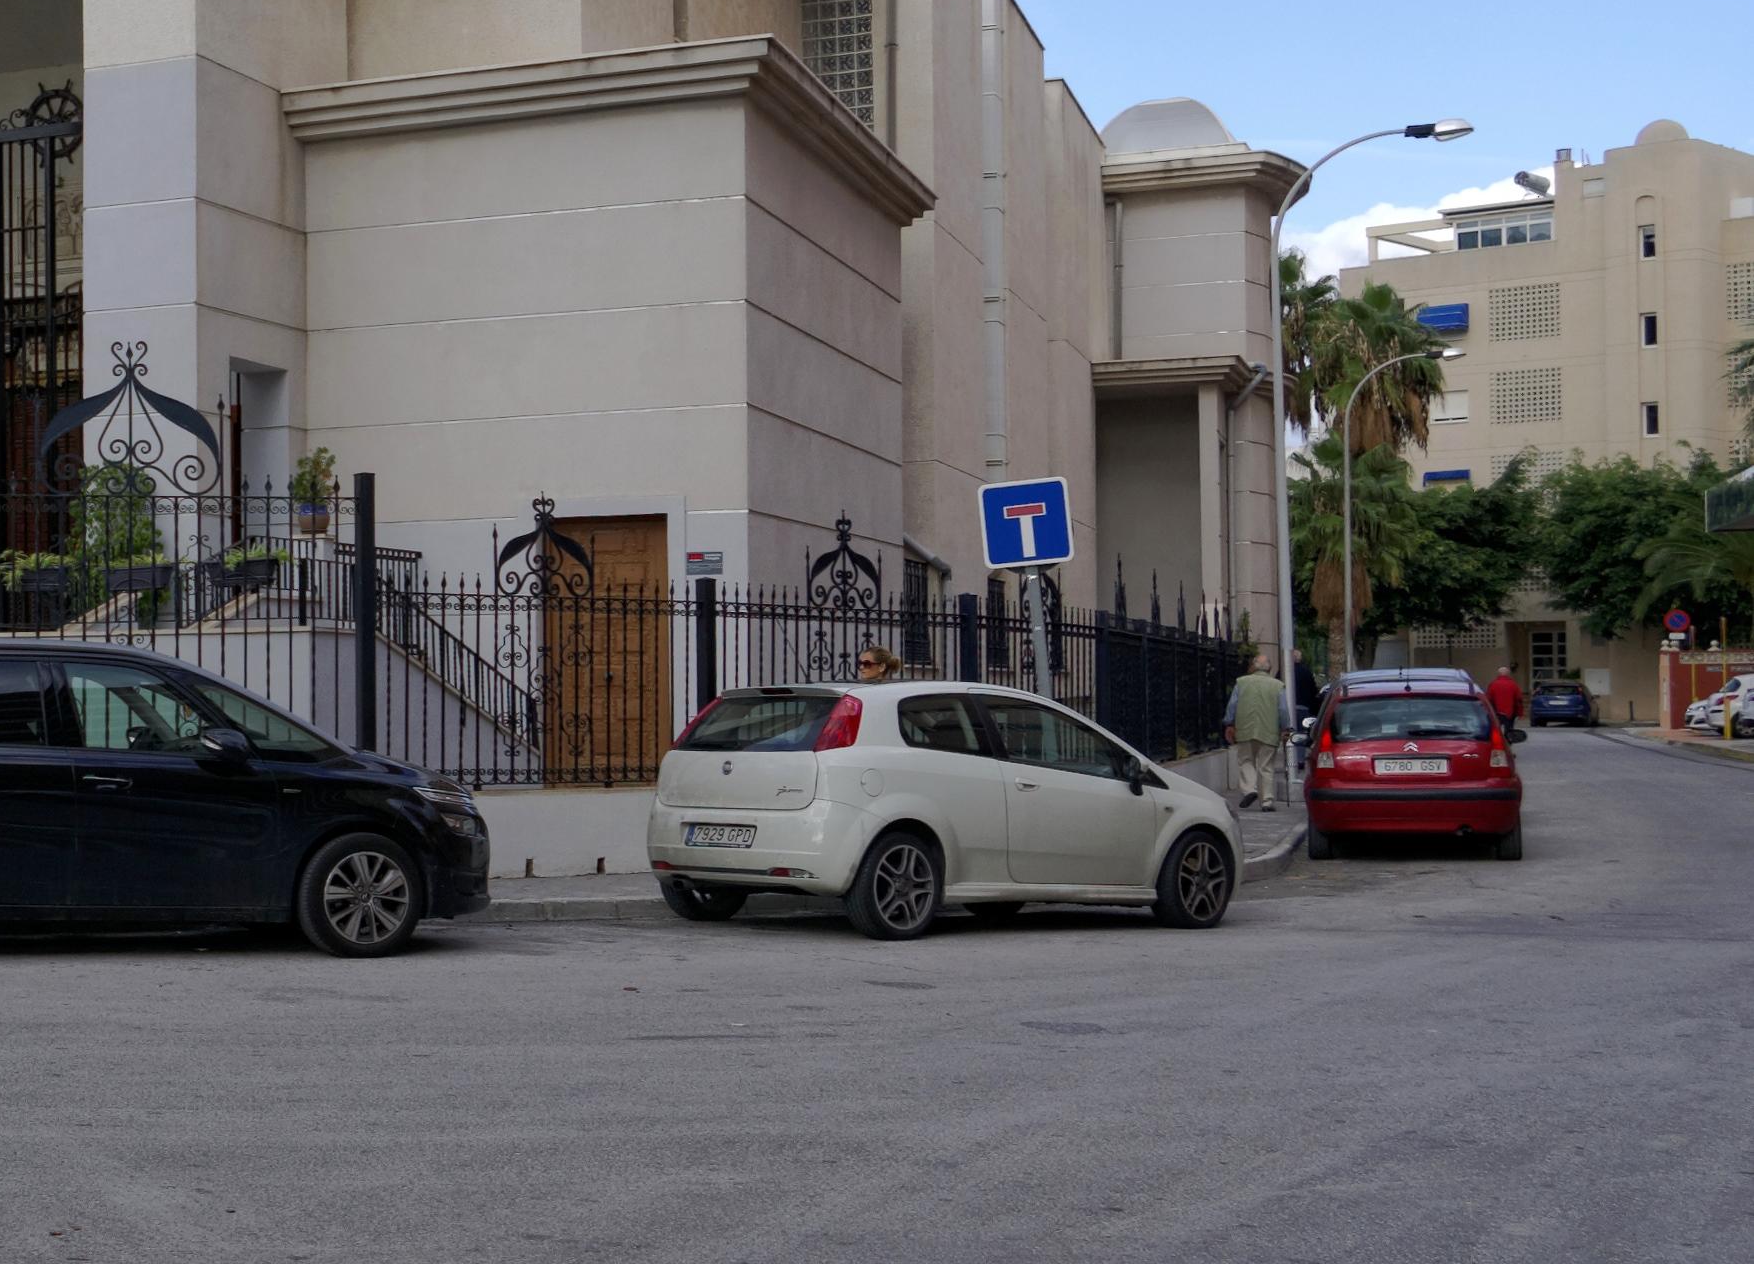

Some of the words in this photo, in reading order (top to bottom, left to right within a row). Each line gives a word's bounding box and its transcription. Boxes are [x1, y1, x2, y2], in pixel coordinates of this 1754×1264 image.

[1384, 761, 1413, 772] 6780
[694, 827, 725, 841] 7929
[727, 828, 752, 843] GPD
